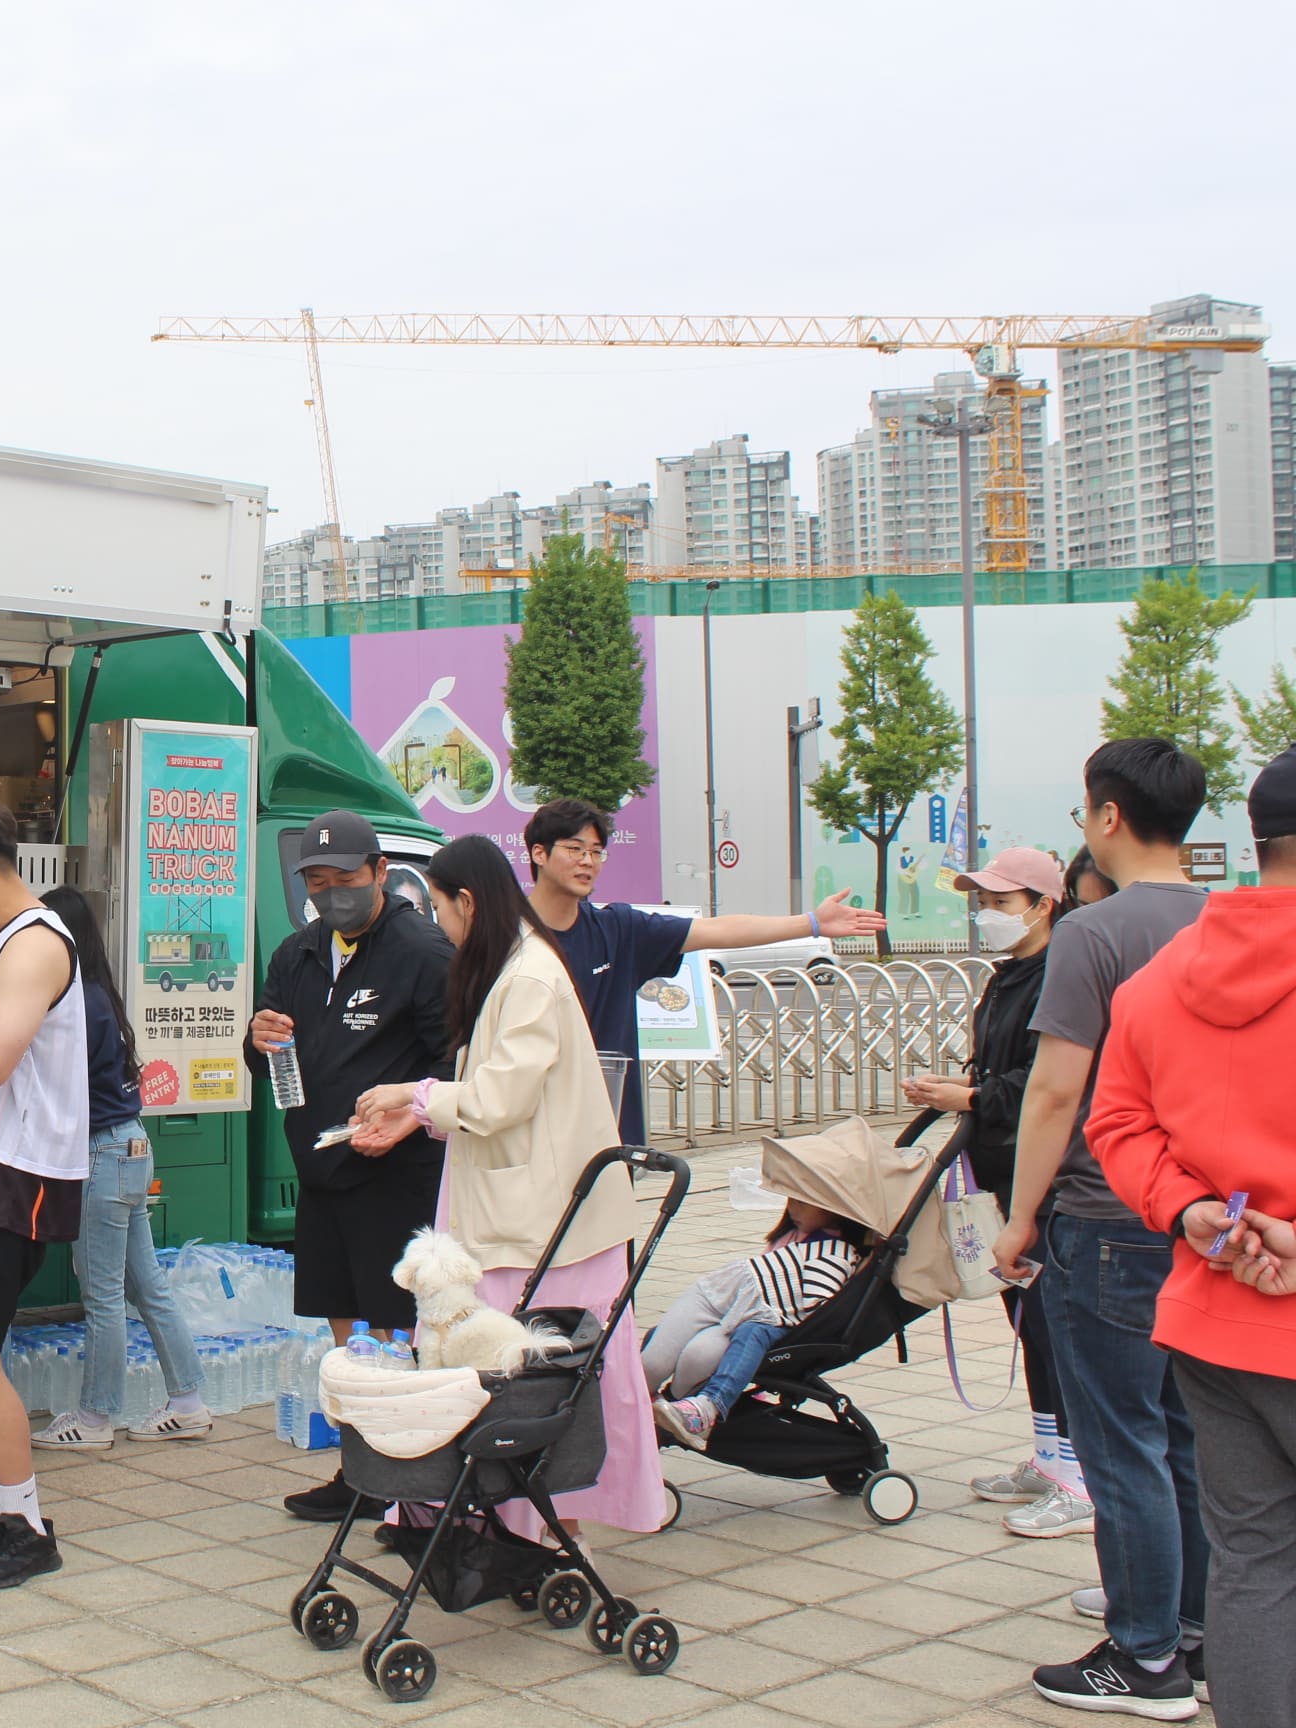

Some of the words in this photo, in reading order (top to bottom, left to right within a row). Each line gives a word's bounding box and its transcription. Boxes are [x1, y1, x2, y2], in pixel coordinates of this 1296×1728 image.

[148, 788, 237, 820] BOBAE
[147, 823, 236, 851] NANUM
[612, 831, 637, 845] 있는
[723, 847, 735, 861] 30
[147, 853, 236, 881] TRUCK
[145, 1007, 195, 1023] 따뜻하고
[199, 1007, 235, 1022] 맛있는
[186, 1025, 235, 1039] 제공합니다
[145, 1071, 168, 1091] FREE
[145, 1080, 175, 1104] ENTRY
[768, 1352, 791, 1363] YOYO
